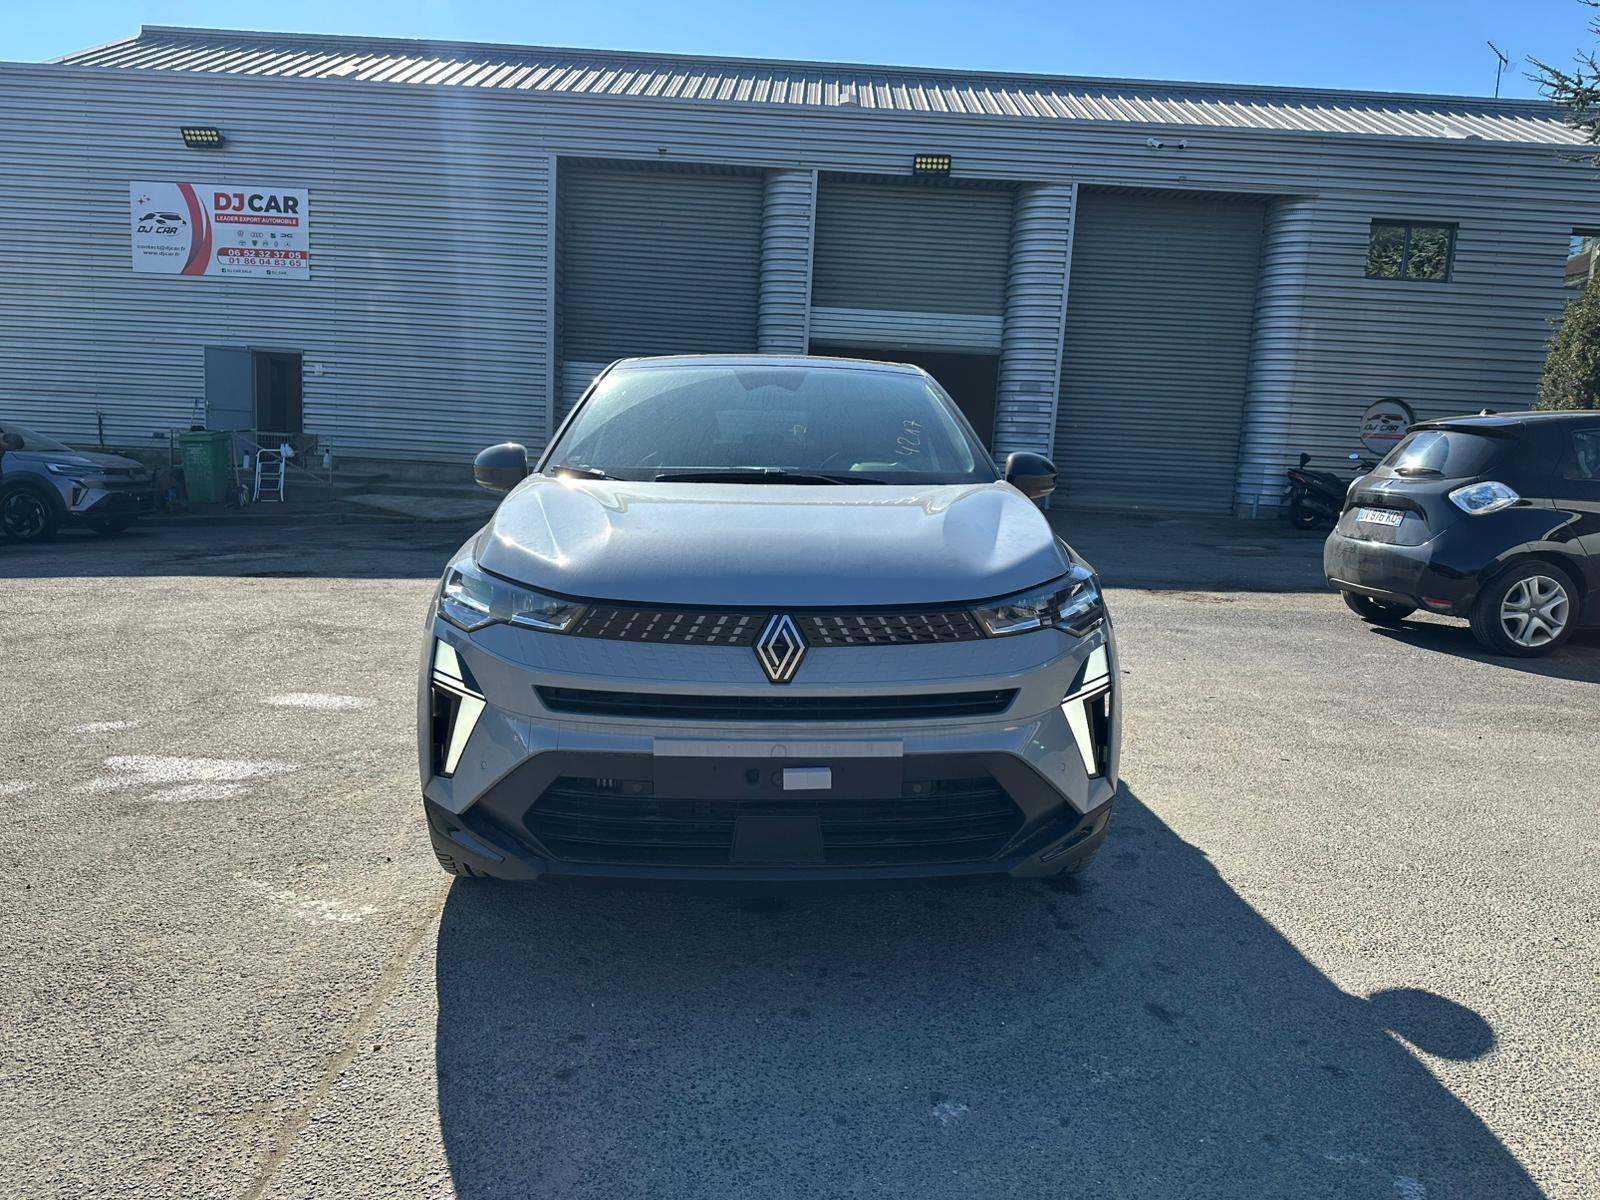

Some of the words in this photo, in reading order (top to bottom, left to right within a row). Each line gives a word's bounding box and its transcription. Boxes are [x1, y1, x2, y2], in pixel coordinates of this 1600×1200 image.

[214, 192, 244, 211] DJ
[248, 193, 298, 214] CAR
[137, 225, 153, 233] DJ
[155, 226, 178, 234] CAR
[243, 249, 255, 257] 52
[258, 250, 270, 258] 32
[288, 251, 301, 259] 05
[289, 259, 302, 267] 65
[1363, 423, 1378, 431] DJ
[1380, 424, 1400, 432] CAR
